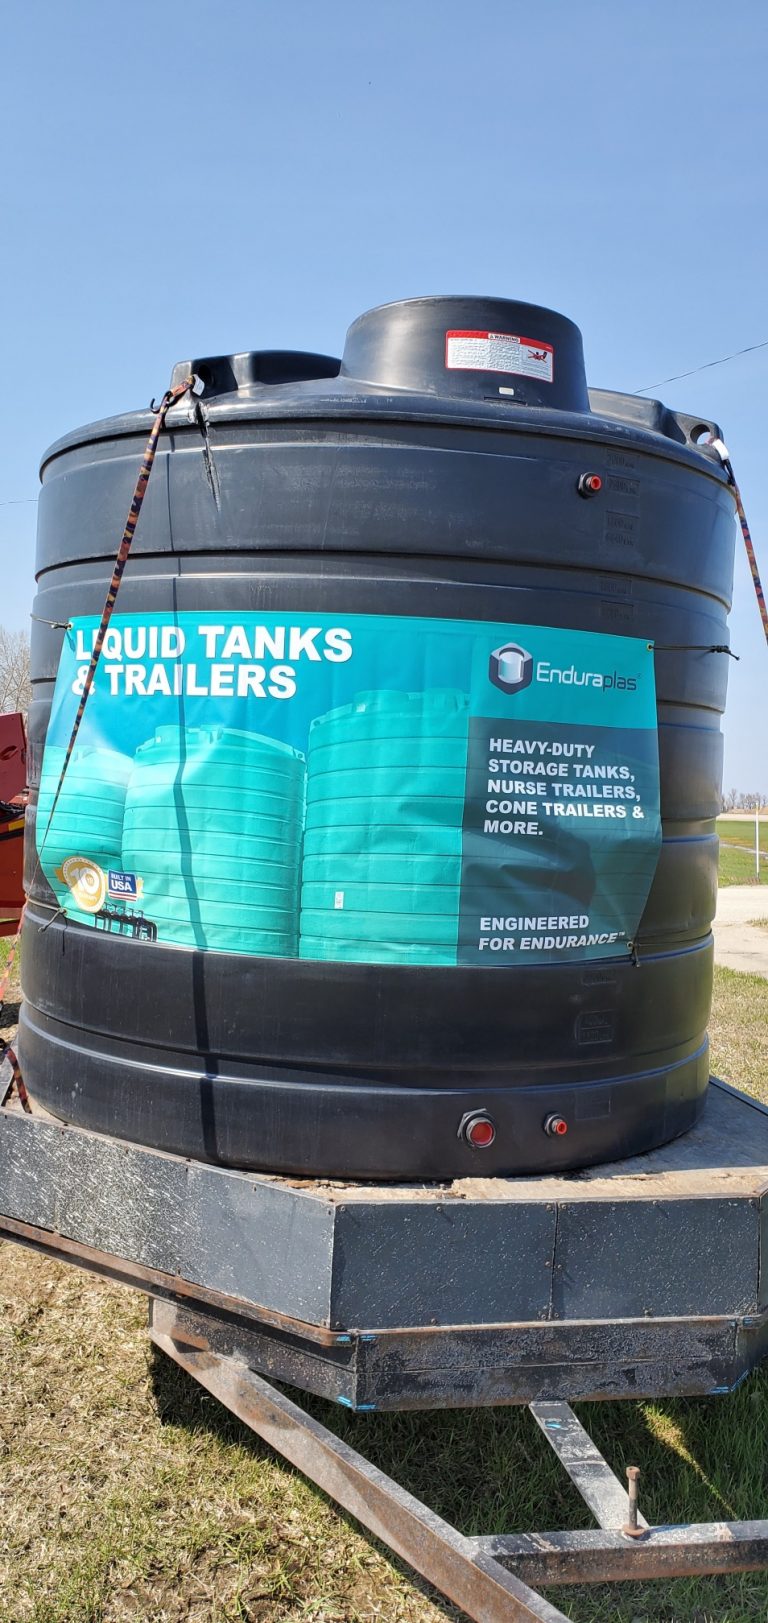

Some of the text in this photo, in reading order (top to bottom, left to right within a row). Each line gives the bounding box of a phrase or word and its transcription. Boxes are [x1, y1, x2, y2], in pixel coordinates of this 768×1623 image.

[75, 625, 353, 663] LIQUID TANKS
[71, 663, 297, 699] & TRAILERS
[536, 661, 637, 692] Enduraplas
[489, 738, 595, 758] HEAVY-DUTY
[488, 759, 635, 783] STORAGE TANKS,
[487, 779, 641, 802] NURSE TRAILERS,
[485, 800, 645, 818] CONE TRAILERS &
[483, 819, 544, 836] MORE.
[110, 872, 132, 882] BUILT IN
[111, 880, 133, 892] USA
[480, 915, 589, 931] ENGINEERED
[478, 937, 515, 951] FOR
